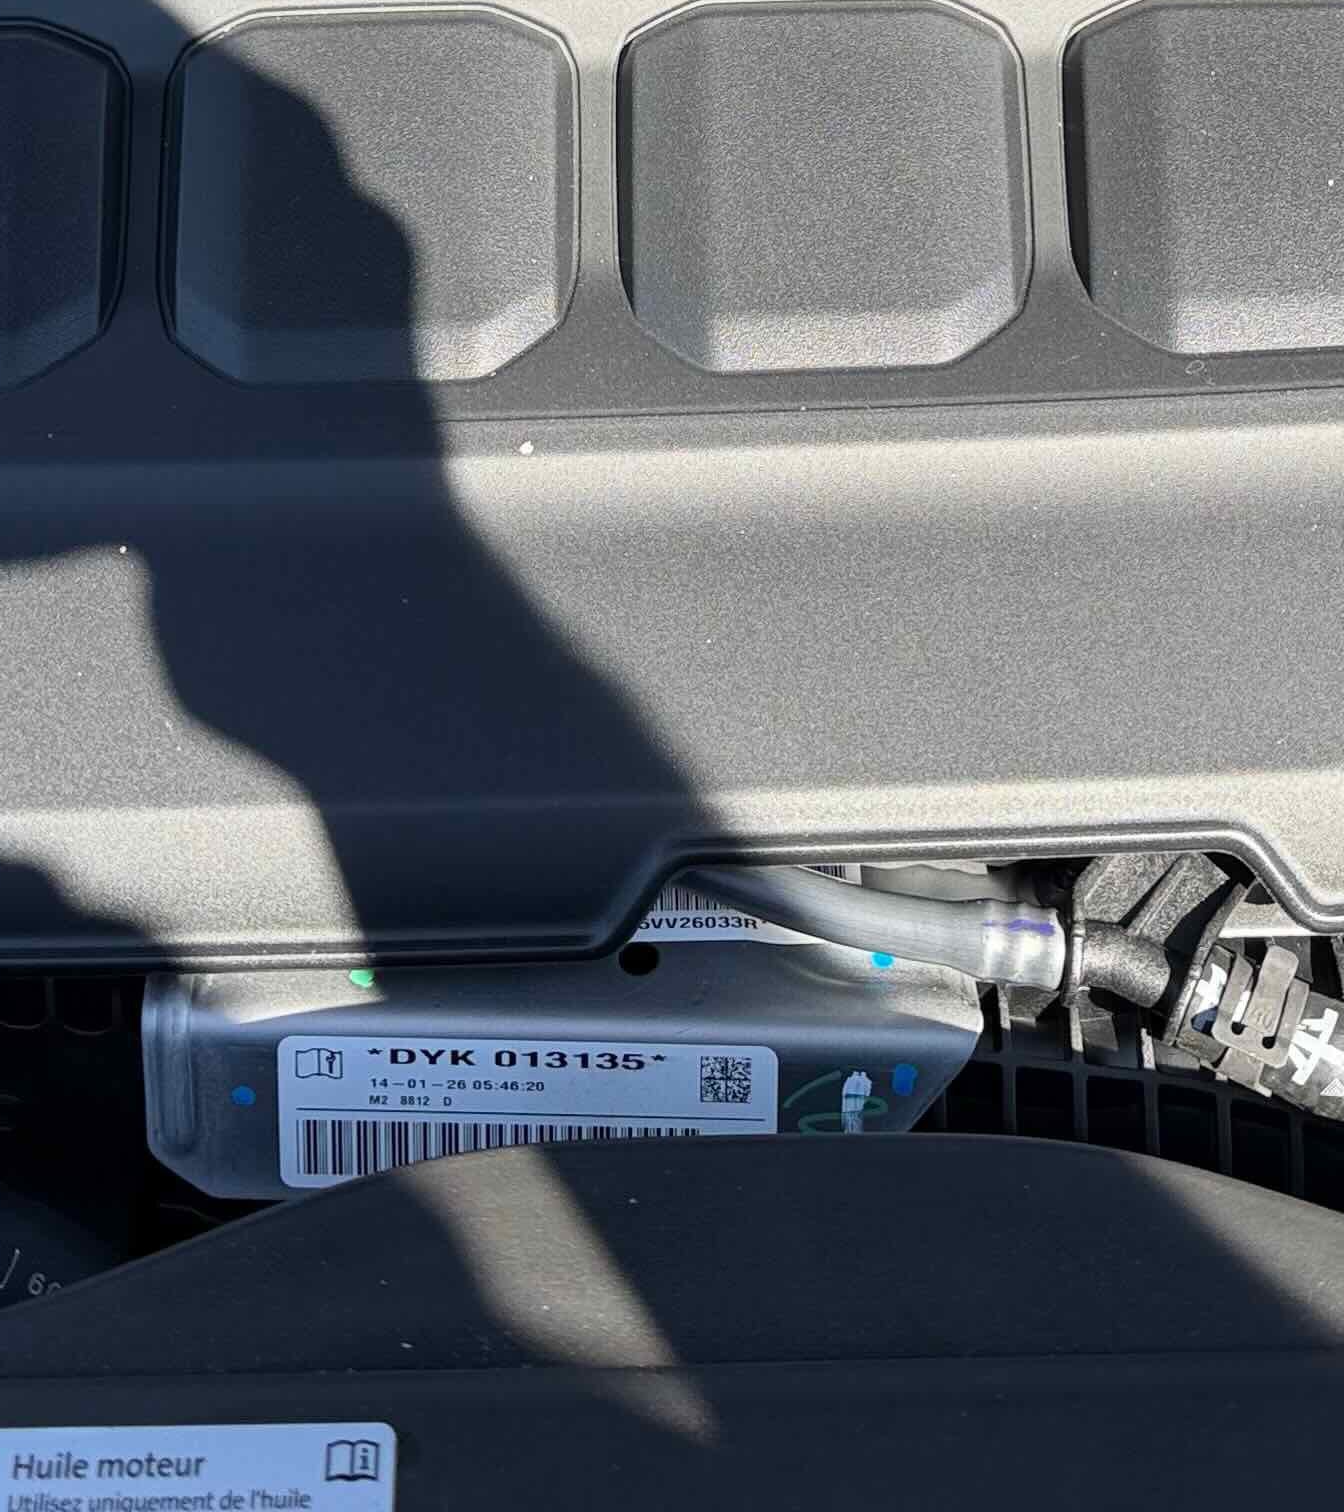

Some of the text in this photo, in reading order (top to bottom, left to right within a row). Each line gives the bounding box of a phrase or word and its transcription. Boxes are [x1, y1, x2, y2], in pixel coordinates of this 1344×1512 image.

[472, 1079, 545, 1092] 05:46:20
[368, 1094, 453, 1107] M2 8812 D
[12, 1451, 90, 1481] Huile
[97, 1457, 206, 1479] moteur
[8, 1493, 83, 1512] Utilisez
[88, 1492, 214, 1512] uniquement
[219, 1490, 245, 1511] de
[250, 1489, 312, 1510] l'huile
